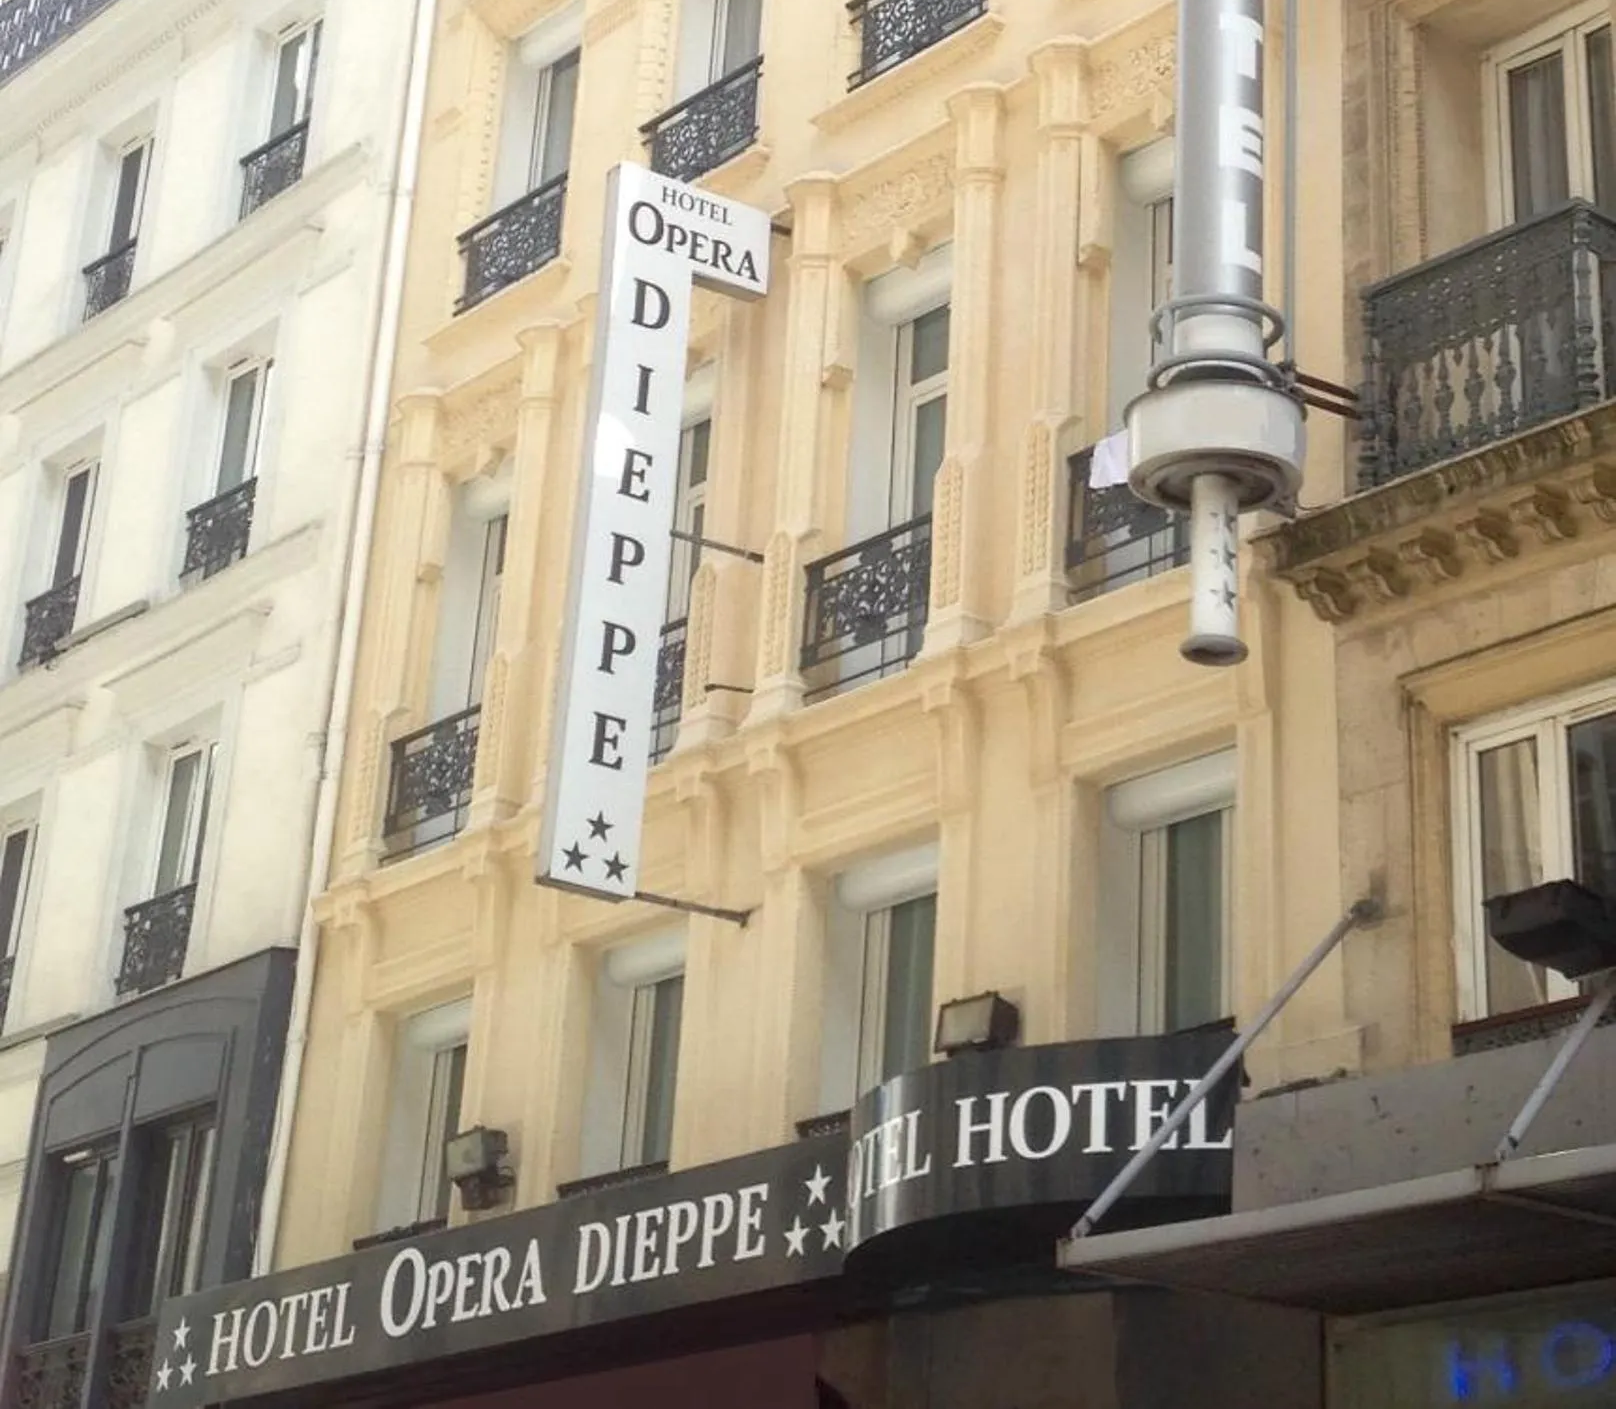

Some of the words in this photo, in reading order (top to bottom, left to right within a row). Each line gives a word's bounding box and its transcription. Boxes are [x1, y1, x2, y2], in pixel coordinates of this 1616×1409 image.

[628, 199, 761, 284] OPERA
[661, 185, 733, 227] HOTEL
[587, 276, 672, 771] DIEPPE
[847, 1109, 932, 1209] OTEL
[951, 1078, 1233, 1168] HOTEL
[205, 1281, 357, 1377] HOTEL
[380, 1237, 547, 1339] OPERA
[572, 1182, 770, 1295] DIEPPE
